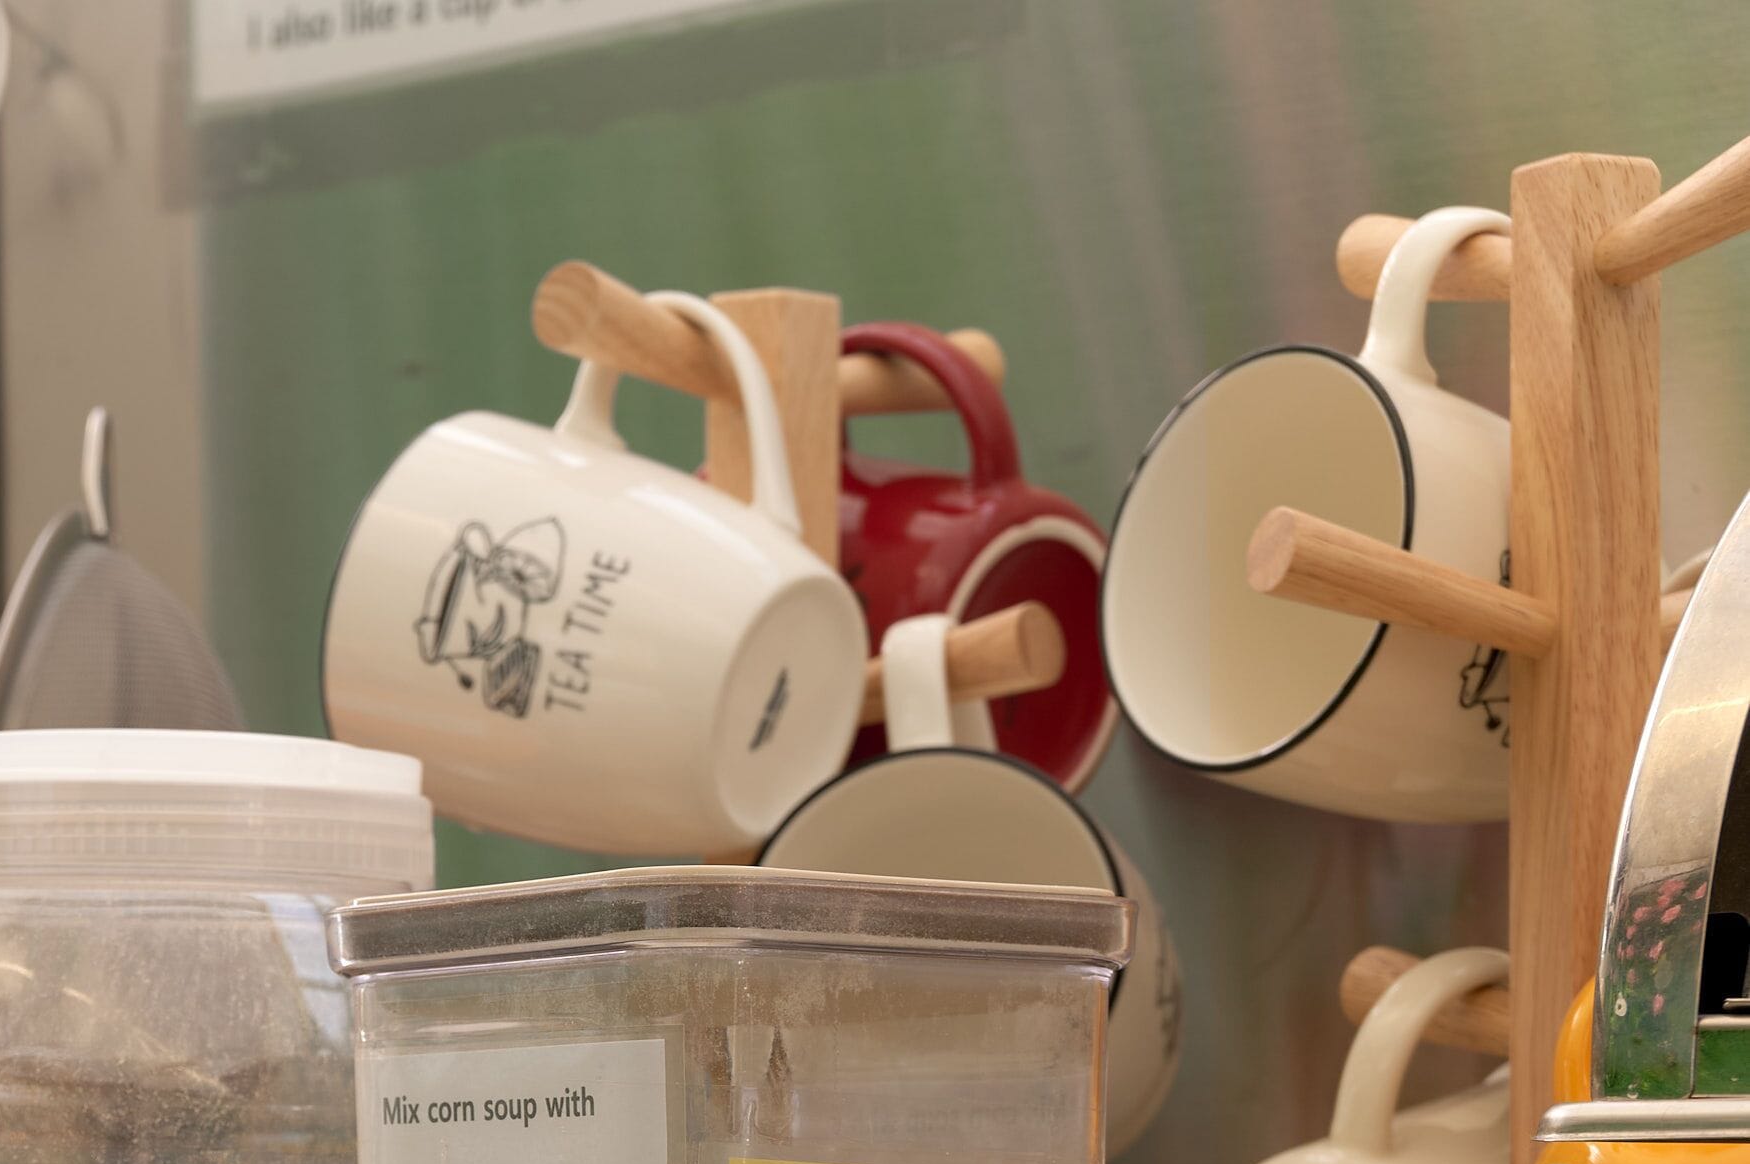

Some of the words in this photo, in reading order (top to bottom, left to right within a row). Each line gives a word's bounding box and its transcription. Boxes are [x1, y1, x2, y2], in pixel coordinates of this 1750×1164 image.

[270, 7, 333, 50] also
[341, 0, 396, 35] like
[562, 550, 632, 635] TIME
[544, 649, 592, 712] TEA
[383, 1095, 420, 1125] Mix
[428, 1100, 475, 1123] corn
[484, 1097, 537, 1128] soup
[545, 1086, 595, 1118] with
